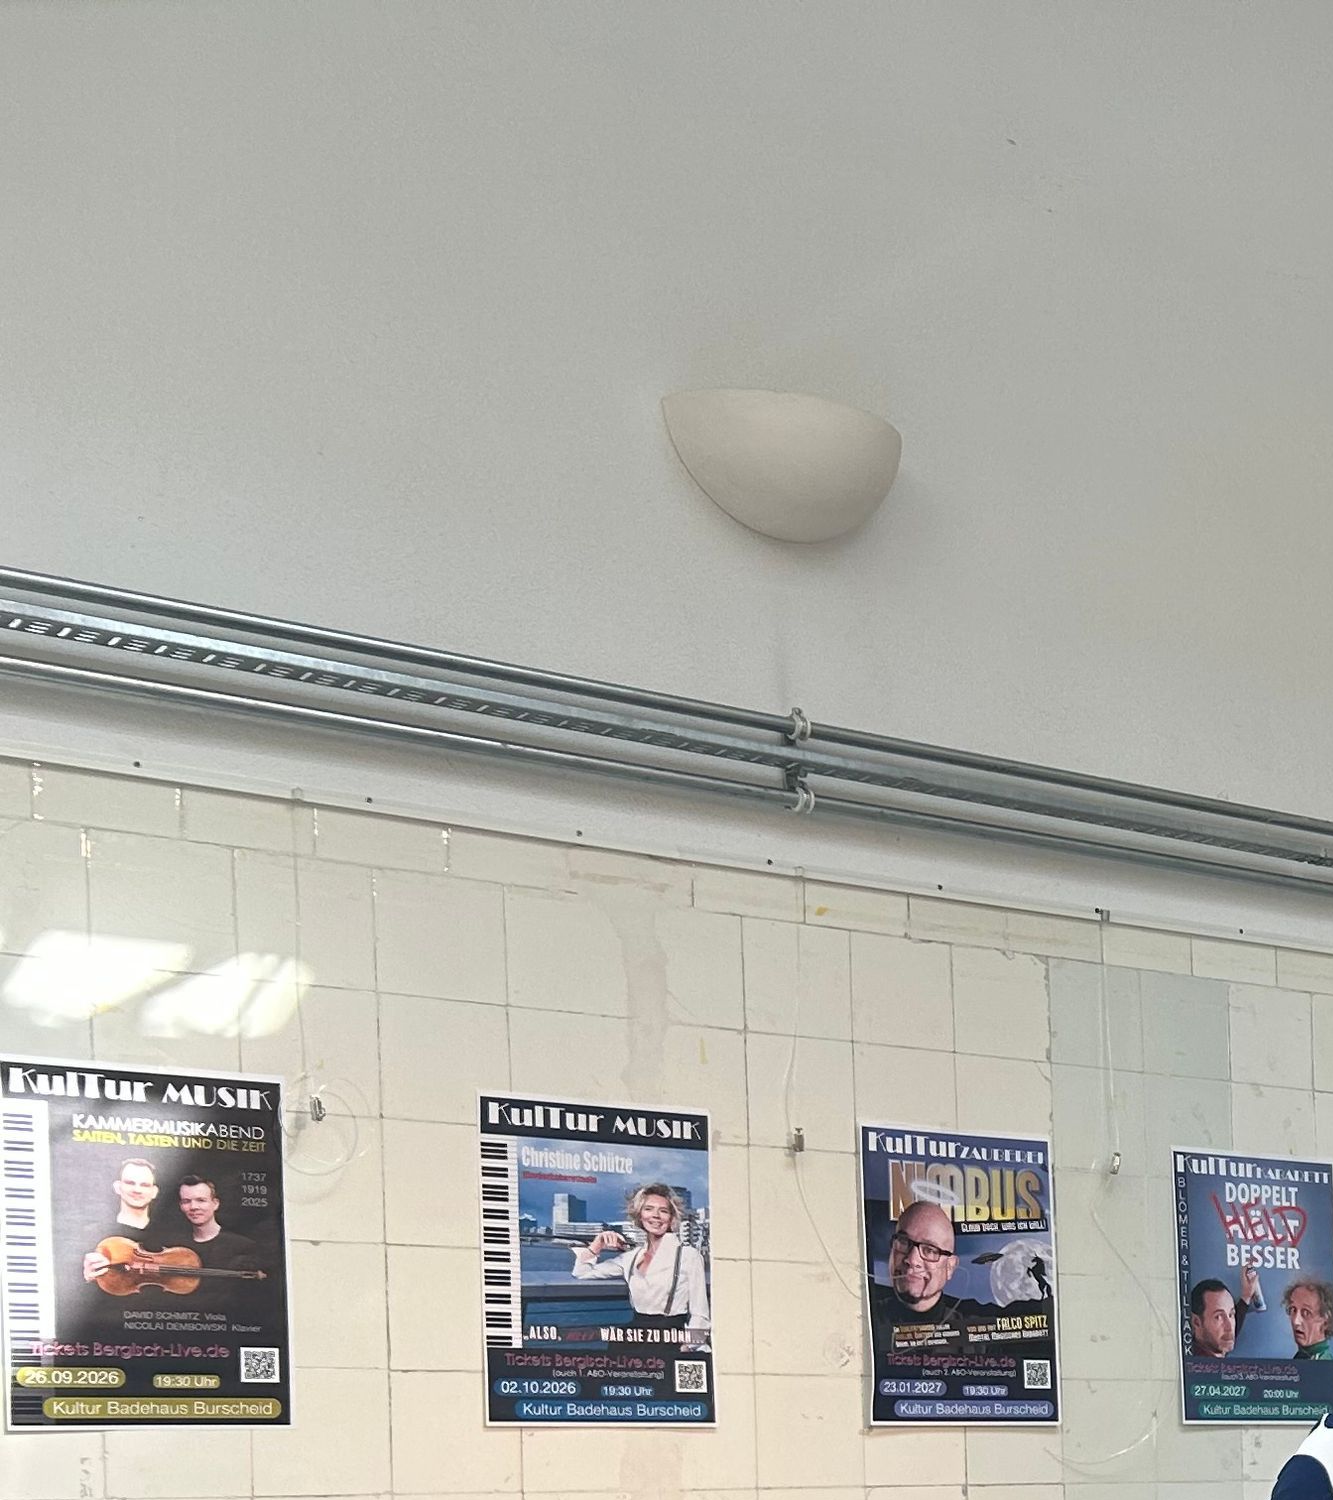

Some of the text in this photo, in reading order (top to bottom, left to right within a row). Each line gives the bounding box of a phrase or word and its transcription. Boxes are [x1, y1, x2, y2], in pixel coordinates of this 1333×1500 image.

[162, 1082, 273, 1111] MUSIK
[72, 1113, 265, 1140] KAMMERMUSIKABEND
[612, 1115, 702, 1141] MUSIK
[128, 1132, 179, 1148] TASTEN
[181, 1136, 212, 1149] UND
[216, 1138, 239, 1151] DIE
[242, 1140, 266, 1153] ZEIT
[521, 1146, 633, 1174] Christine Schütze
[1225, 1182, 1298, 1207] DOPPELT
[1226, 1243, 1301, 1270] BESSER
[996, 1316, 1023, 1331] FALCO
[1023, 1314, 1048, 1329] SPITZ
[600, 1325, 624, 1342] WÄR
[626, 1328, 644, 1342] SIE
[646, 1328, 660, 1343] ZU
[25, 1370, 218, 1388] 26.09.2026 19:30 Uhr
[883, 1381, 942, 1394] 23.01.2027
[501, 1382, 577, 1394] 02.10.2026
[633, 1385, 653, 1396] Uhr
[1194, 1385, 1246, 1397] 27.04.2027
[53, 1401, 273, 1415] Kultur Badehaus Burscheid
[523, 1403, 701, 1417] Kultur Badehaus Burscheid
[901, 1402, 1049, 1415] Kultur Badehaus Burscheid
[1203, 1405, 1230, 1414] Kultur
[1233, 1405, 1280, 1415] Badehaus
